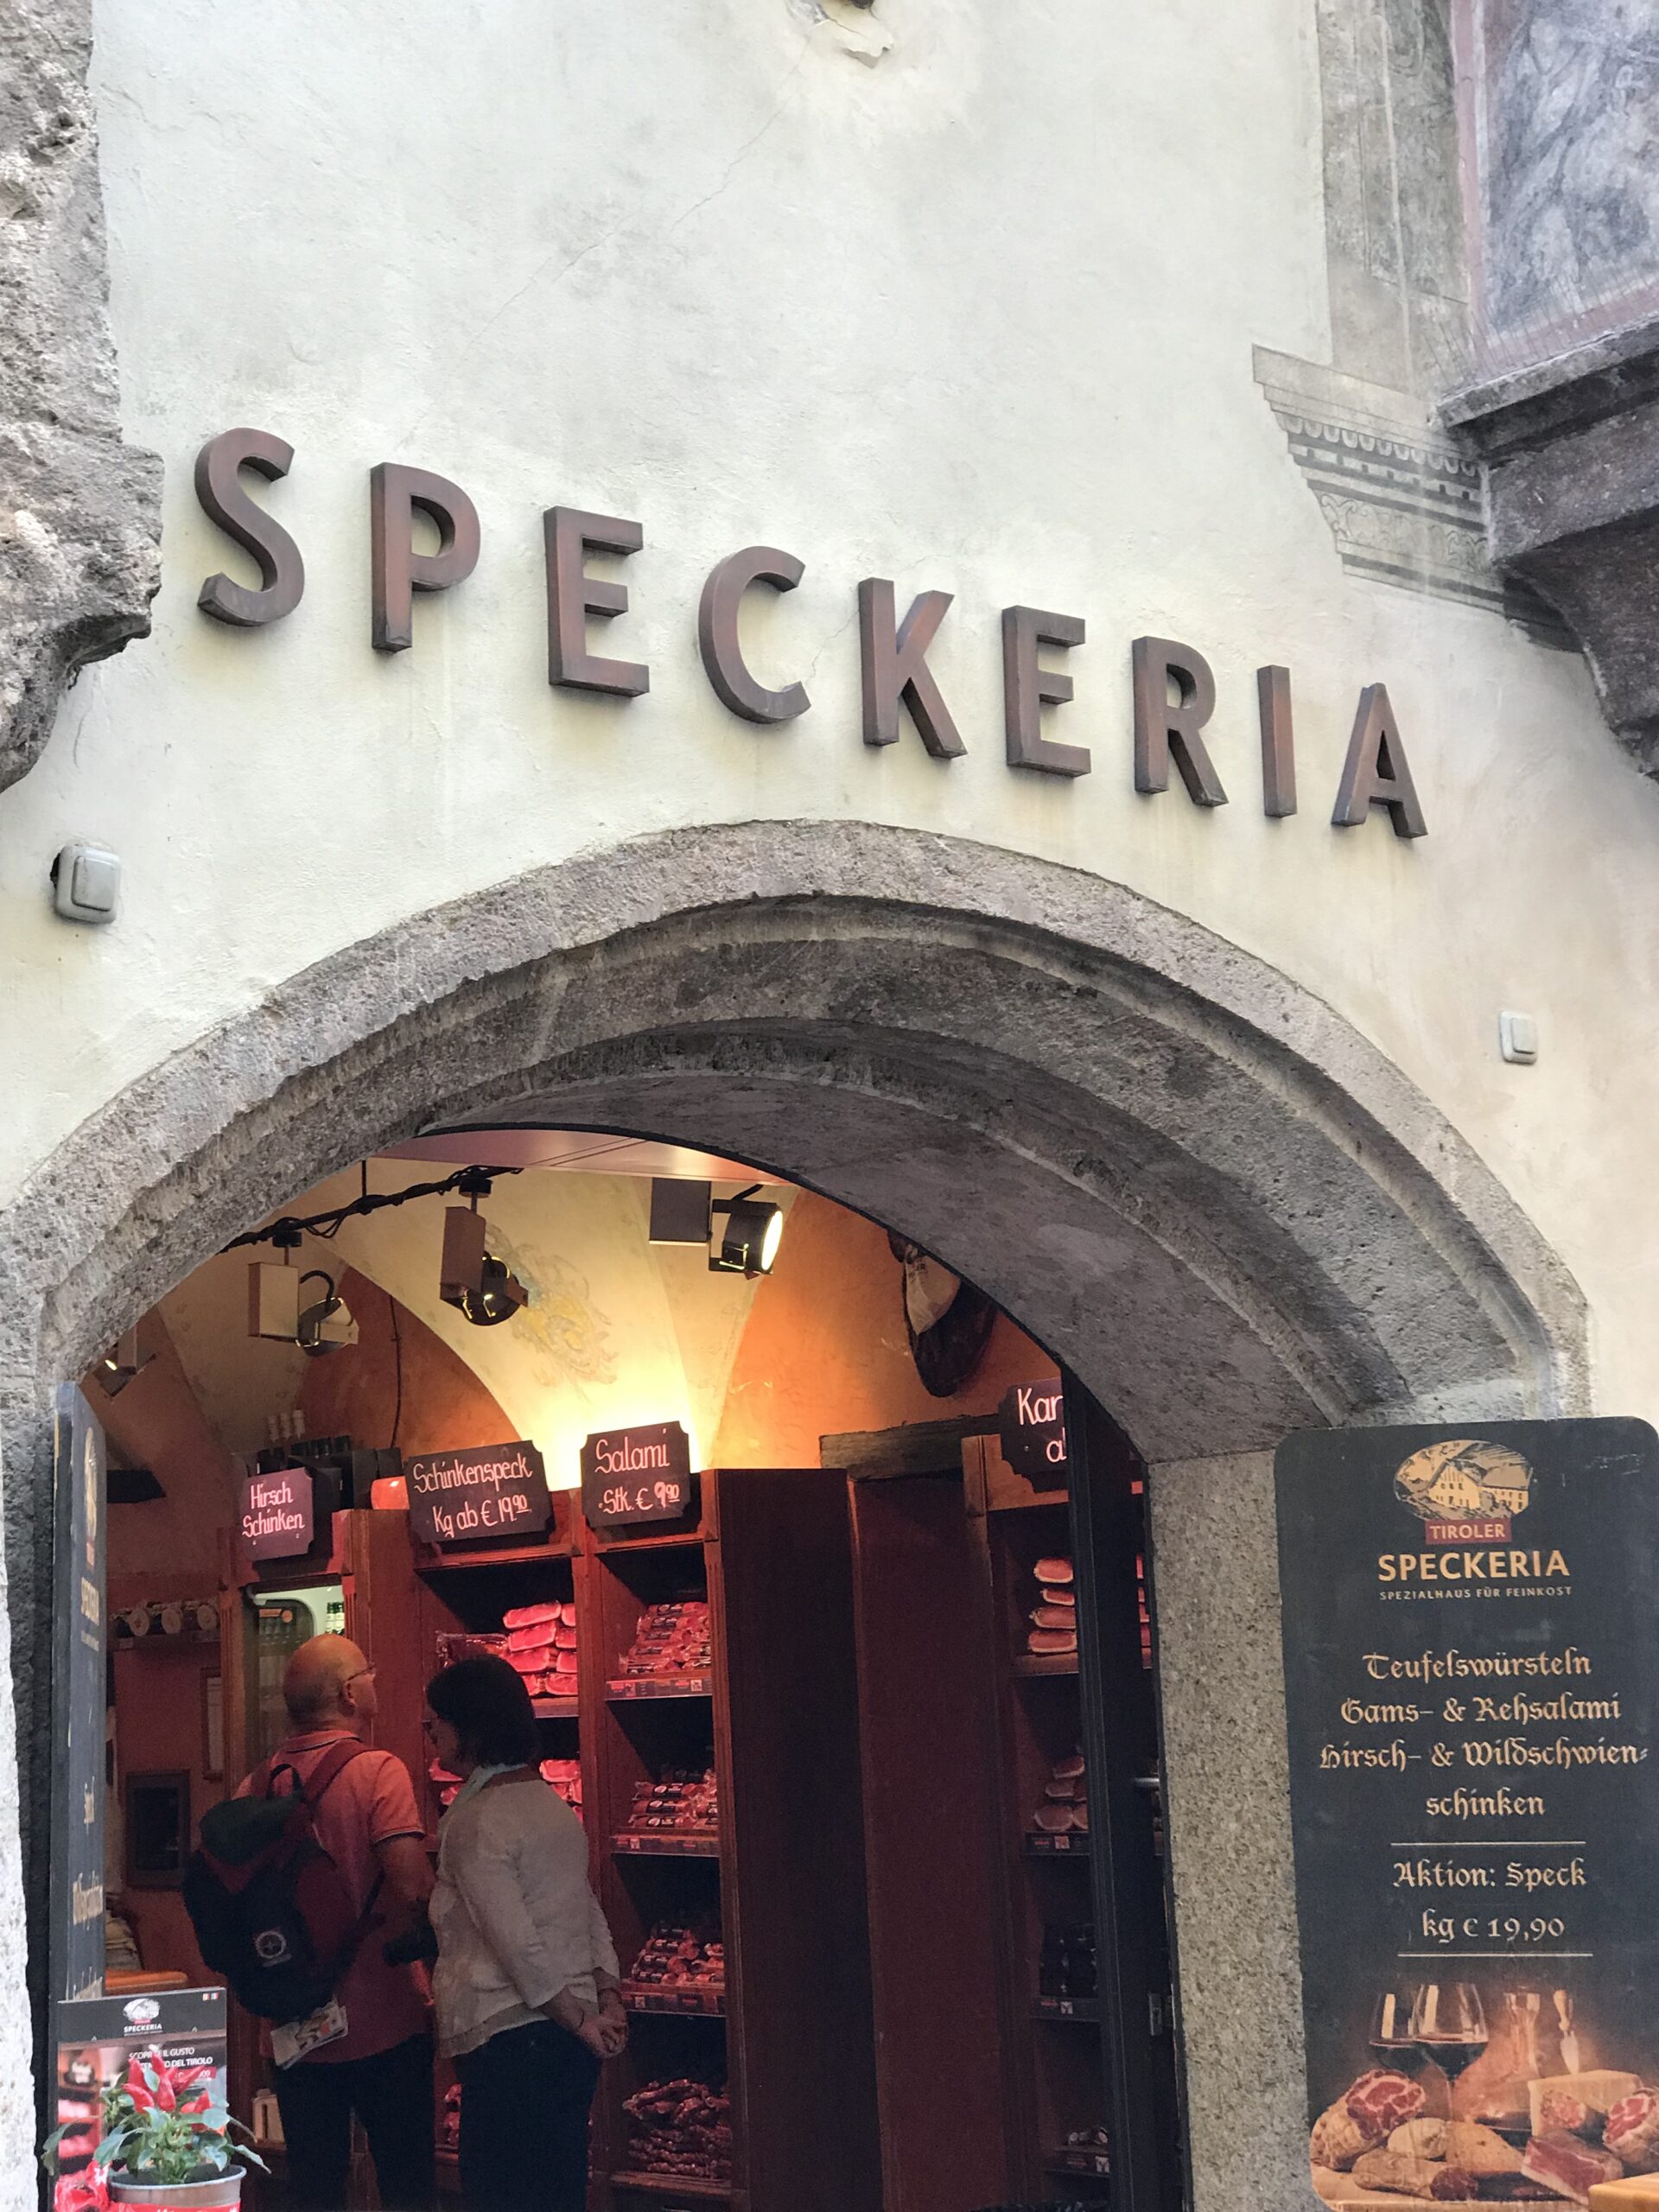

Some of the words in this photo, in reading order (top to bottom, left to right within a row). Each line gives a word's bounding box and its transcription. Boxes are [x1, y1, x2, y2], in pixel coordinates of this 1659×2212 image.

[194, 427, 1428, 840] SPECKERIA
[594, 1428, 671, 1473] Salami
[413, 1452, 533, 1493] Schinkenspeck
[251, 1481, 294, 1510] Hirsch
[635, 1488, 653, 1510] €
[242, 1509, 305, 1538] Schinken
[432, 1505, 455, 1539] Kg
[456, 1501, 479, 1530] ab
[480, 1499, 498, 1527] €
[1429, 1523, 1506, 1540] TIROLER
[1377, 1550, 1571, 1582] SPECKERIA
[1380, 1588, 1471, 1600] SPEZIALHAUS
[1477, 1586, 1501, 1598] FÜR
[1506, 1586, 1572, 1597] FEINKOST
[1362, 1646, 1592, 1684] Teufelswürsteln
[1340, 1698, 1434, 1725] Gams-
[1442, 1697, 1467, 1723] &
[1472, 1691, 1622, 1726] Rehsalami
[1319, 1738, 1421, 1772] Hirsch-
[1431, 1742, 1455, 1767] &
[1426, 1787, 1546, 1821] schinken
[1393, 1859, 1496, 1887] Aktion:
[1505, 1858, 1586, 1892] Speck
[1422, 1908, 1455, 1943] kg
[1488, 1917, 1565, 1942] 19,90
[124, 2023, 162, 2033] SPECKERIA
[169, 2047, 195, 2056] GUSTO
[171, 2059, 186, 2068] DEL
[186, 2056, 213, 2066] TIROLO
